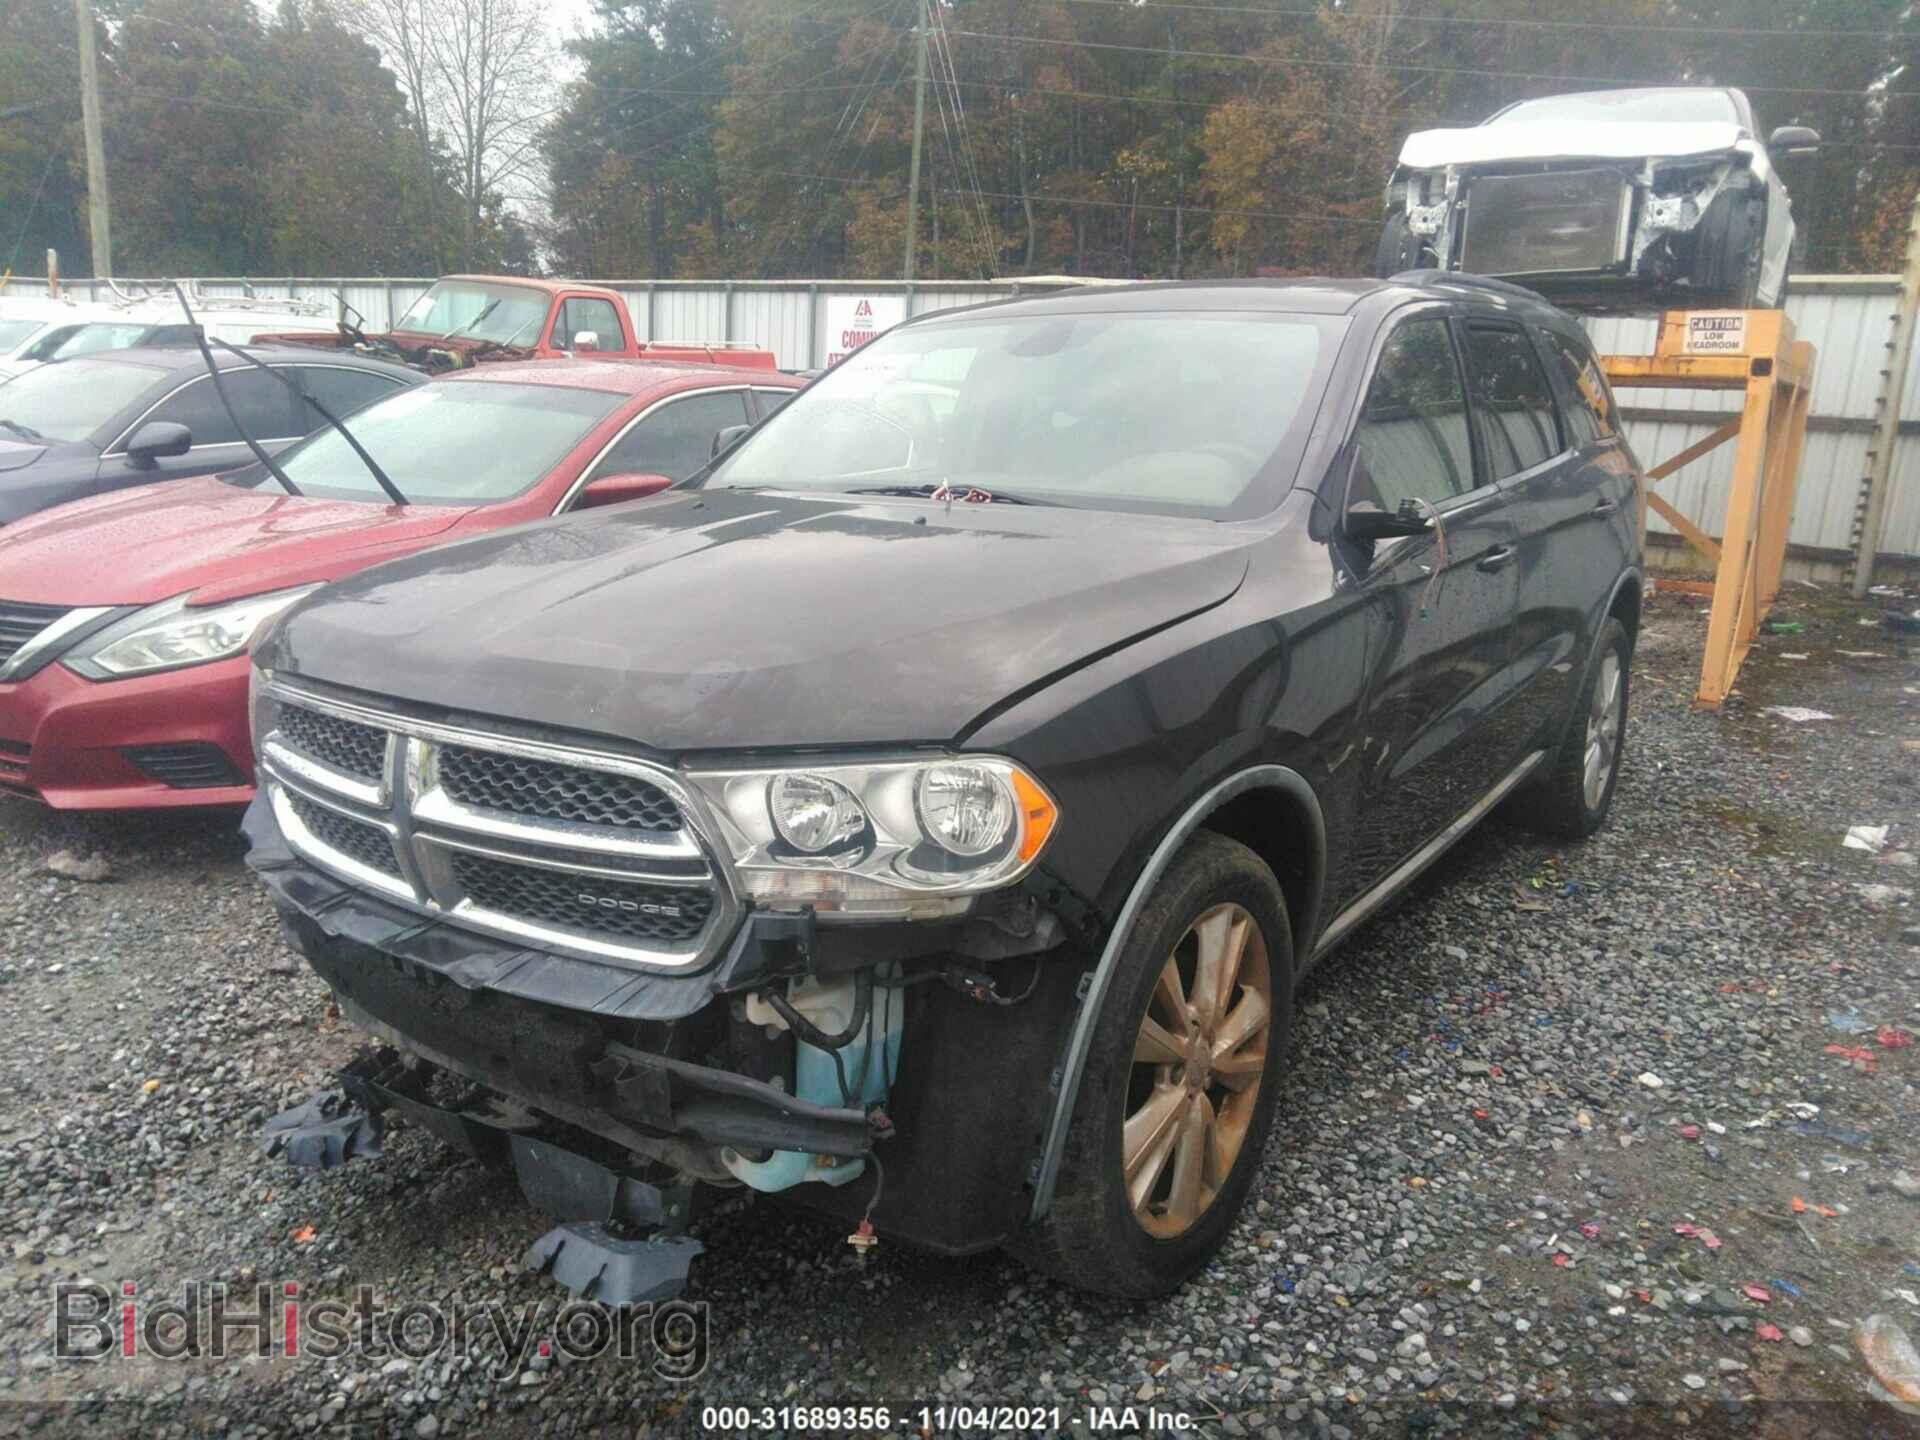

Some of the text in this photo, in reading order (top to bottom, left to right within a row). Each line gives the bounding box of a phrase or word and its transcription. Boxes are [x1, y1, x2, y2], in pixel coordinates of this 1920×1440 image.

[1690, 319, 1742, 329] CAUTION
[842, 330, 882, 348] COMI
[1704, 332, 1725, 340] LOW
[578, 894, 681, 916] DODGE
